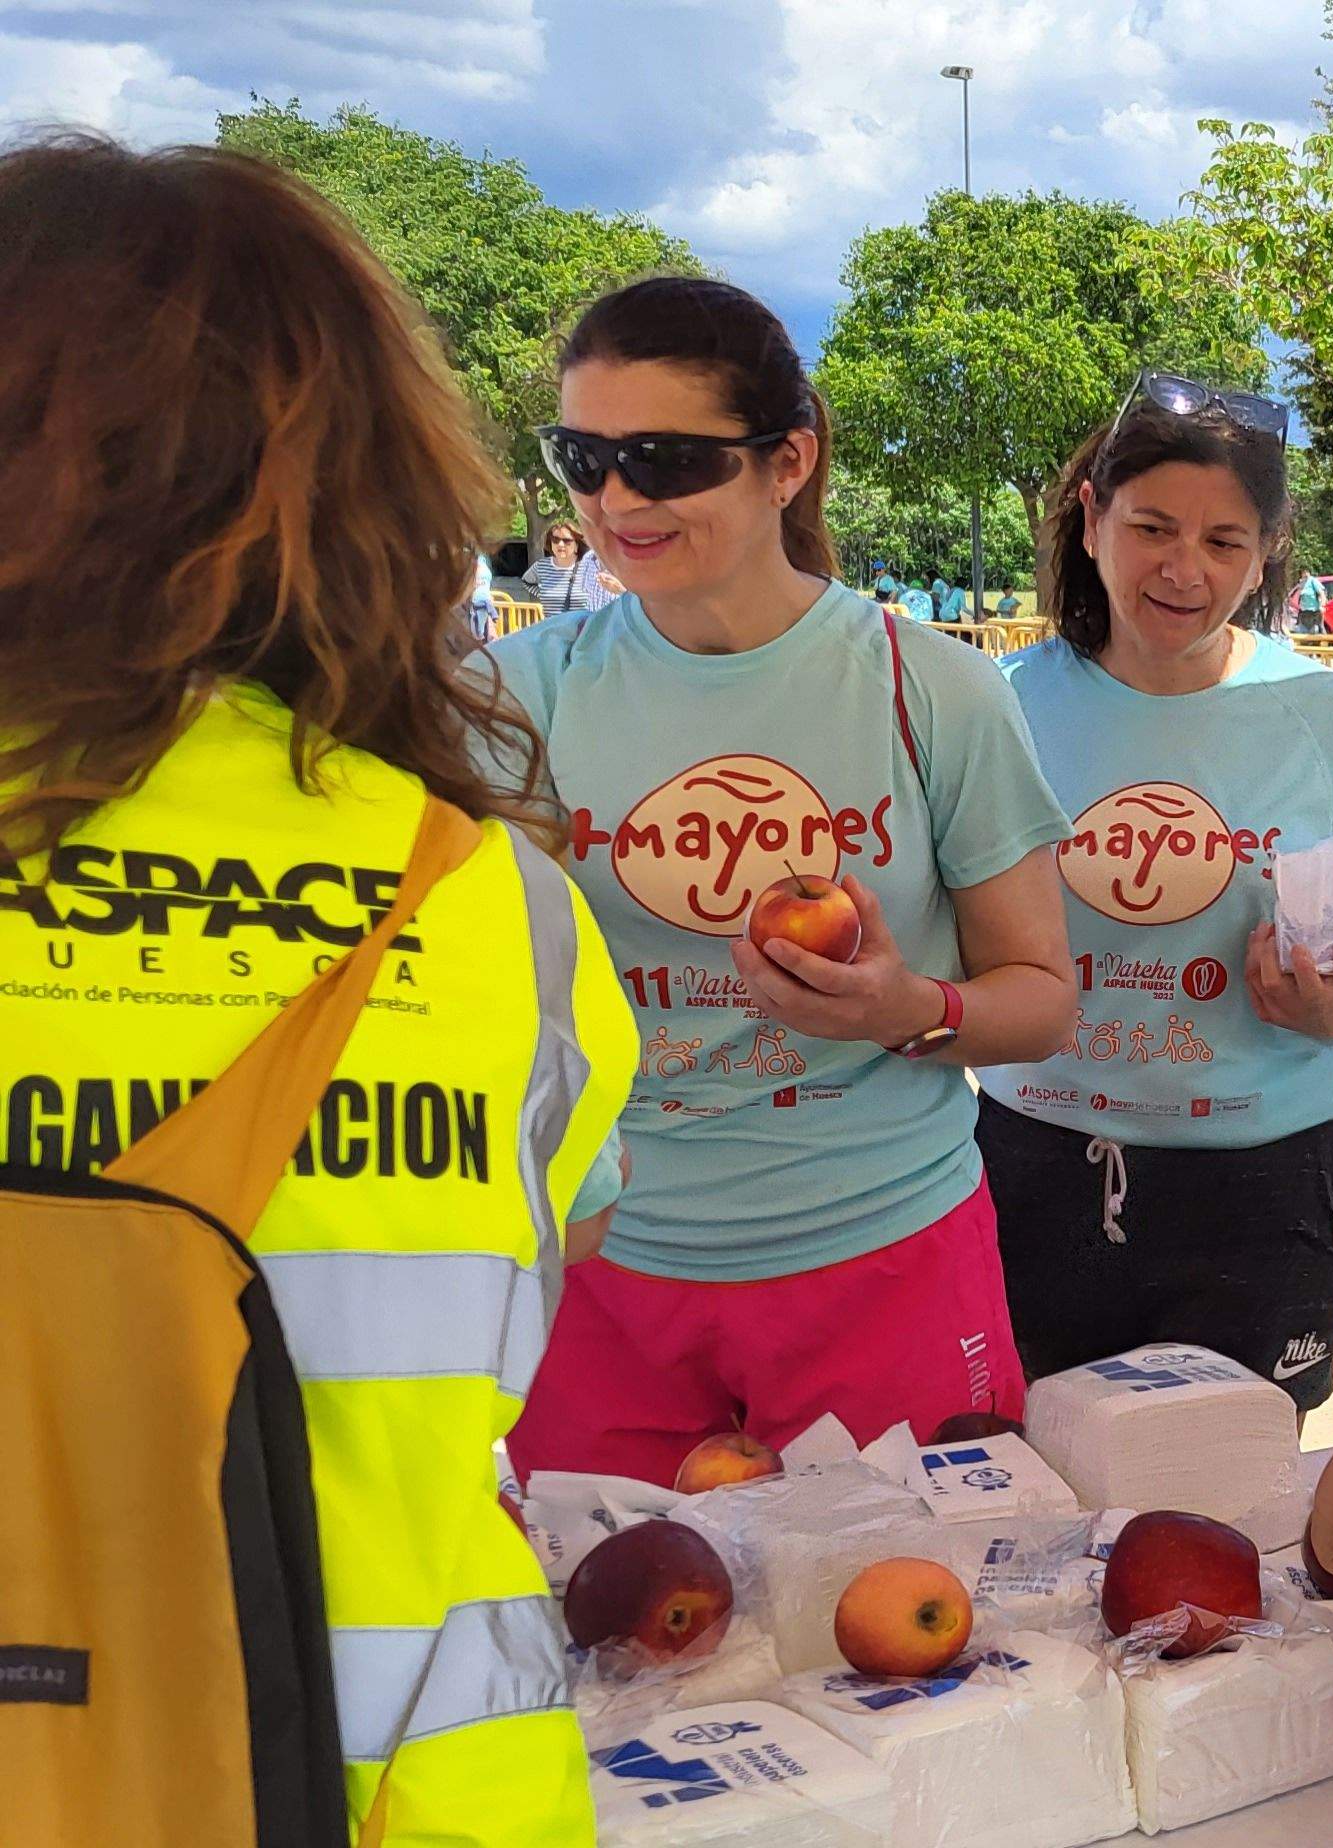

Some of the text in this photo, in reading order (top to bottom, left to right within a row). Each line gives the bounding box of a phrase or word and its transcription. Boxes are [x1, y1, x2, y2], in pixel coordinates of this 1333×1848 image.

[683, 965, 748, 995] Marc
[1104, 952, 1178, 981] Marcha
[0, 982, 78, 1001] ciación
[86, 985, 112, 1001] de
[119, 987, 214, 1006] Personas
[219, 992, 258, 1007] con
[686, 997, 728, 1009] ASPACE
